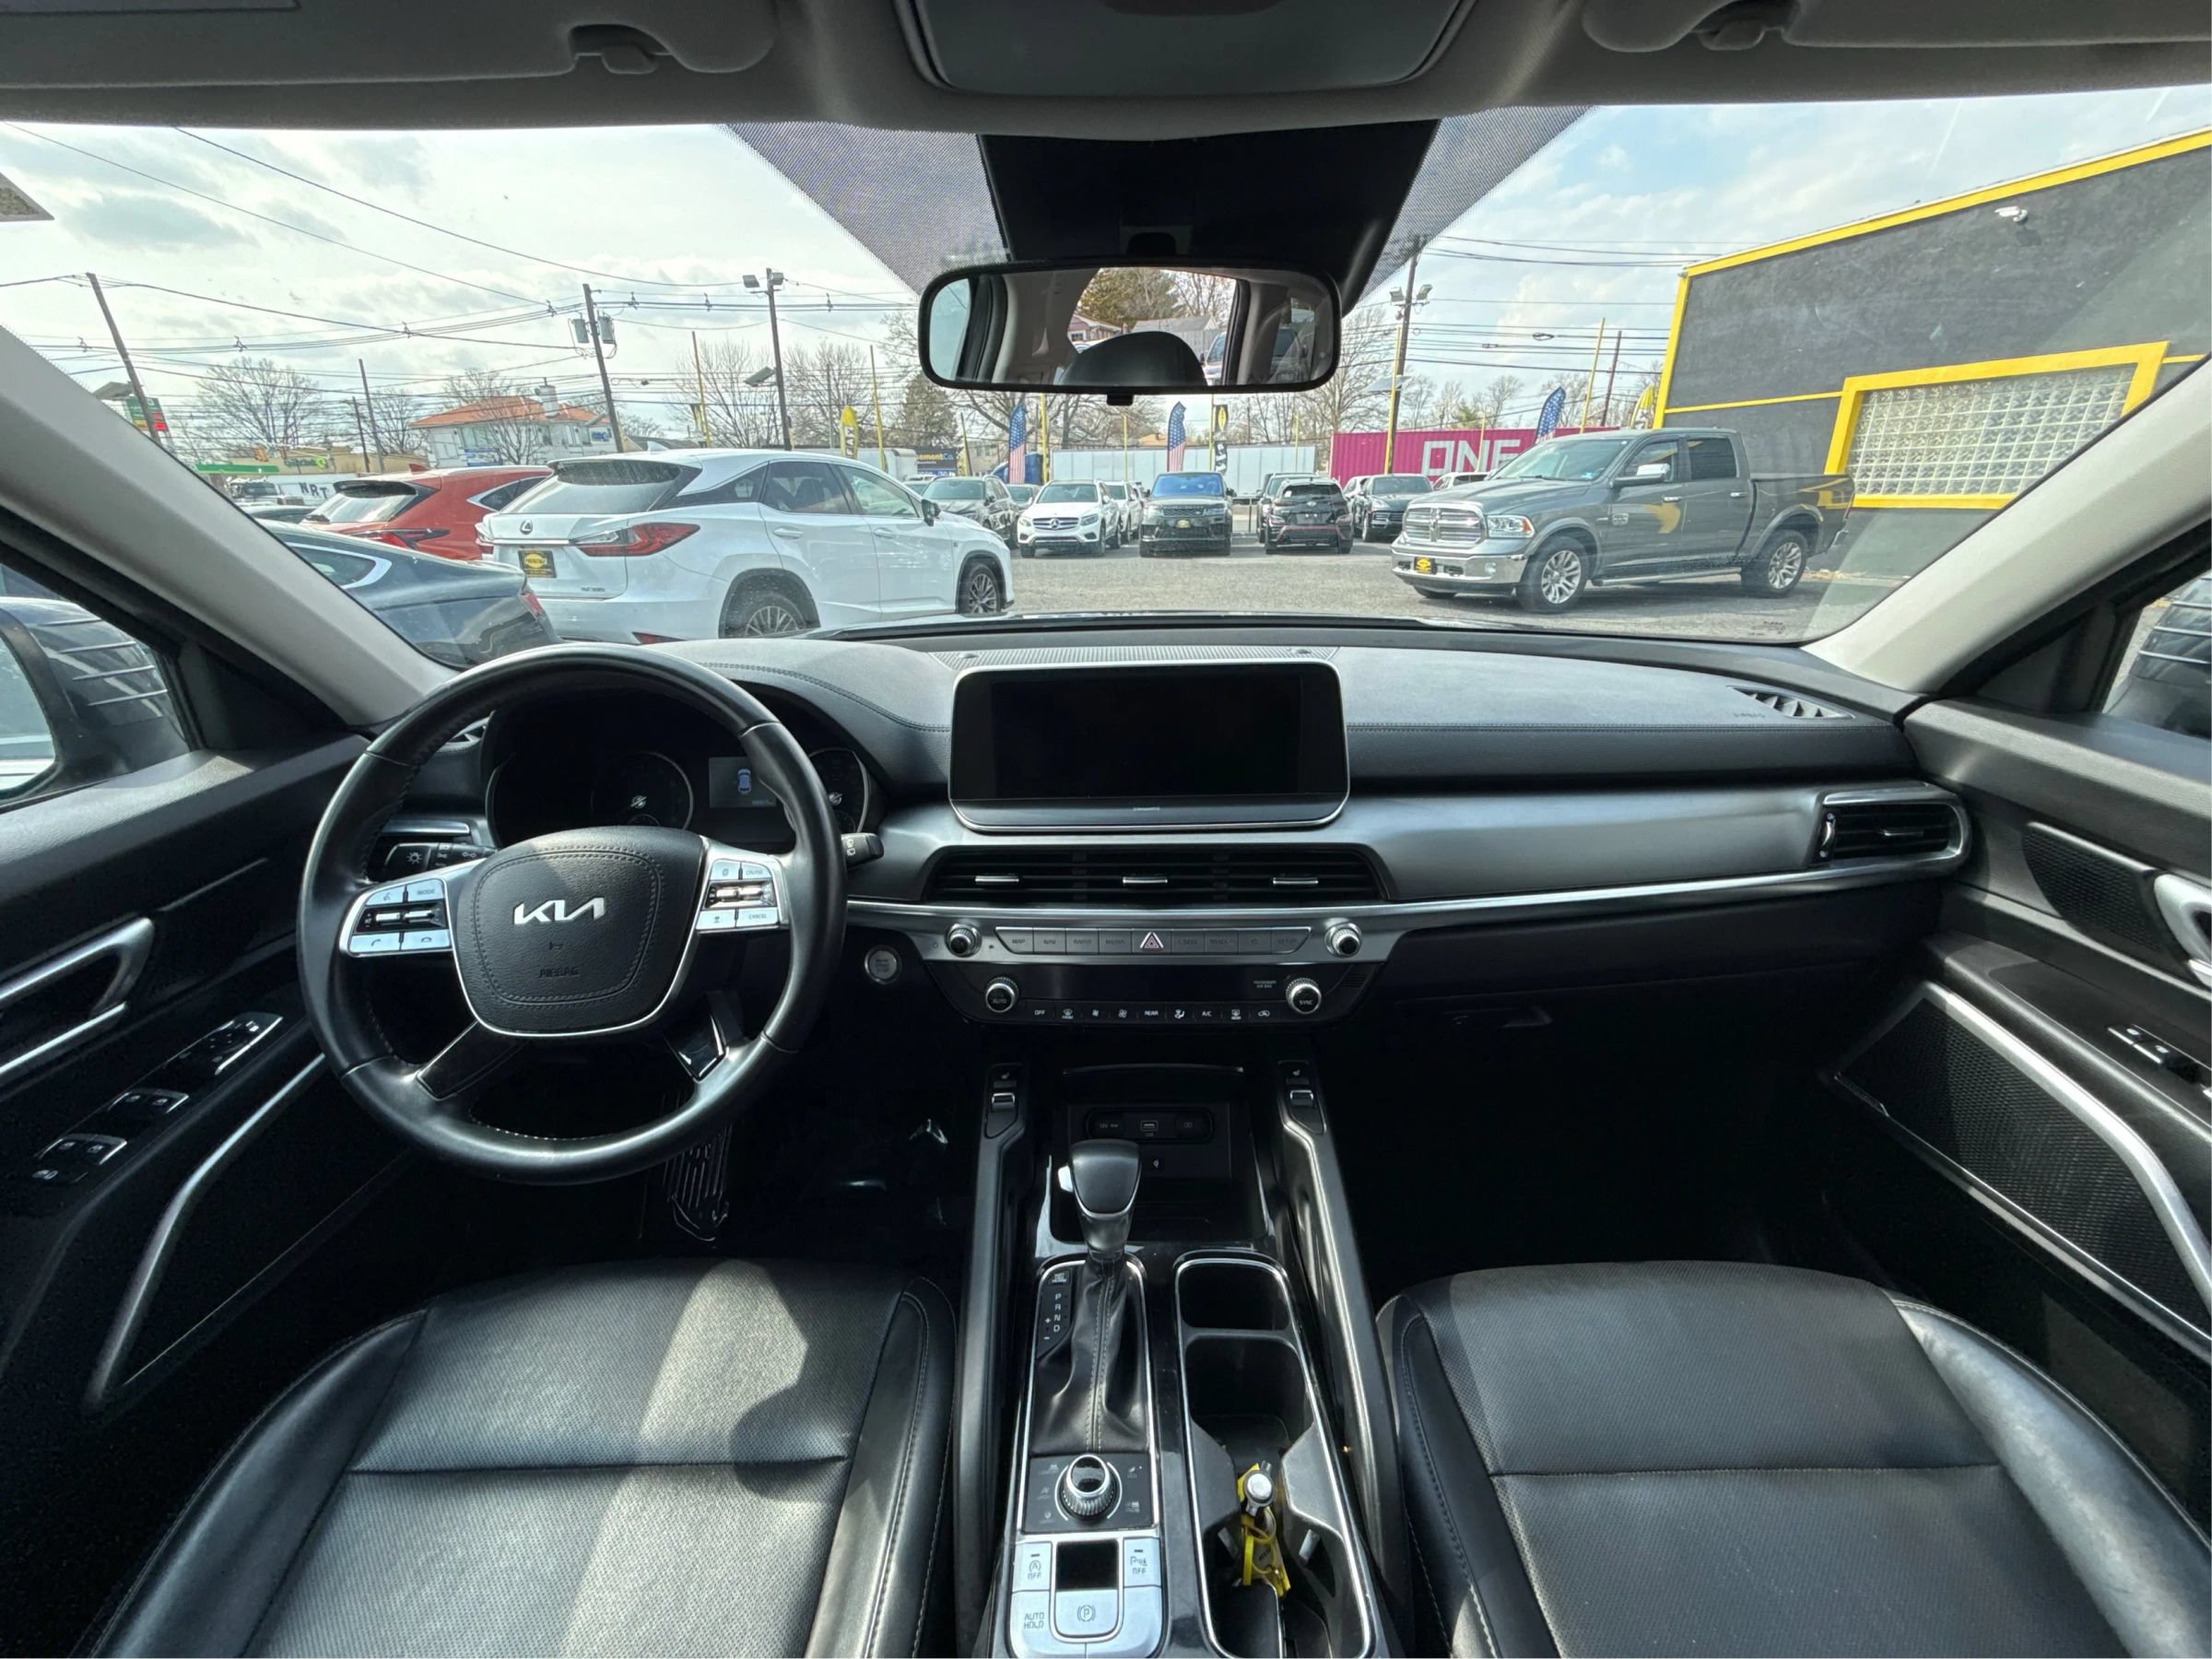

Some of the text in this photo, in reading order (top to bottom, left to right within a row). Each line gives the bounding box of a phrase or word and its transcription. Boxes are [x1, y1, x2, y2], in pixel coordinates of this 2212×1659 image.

[1421, 440, 1521, 476] ONE
[299, 482, 329, 500] NRT
[513, 898, 606, 924] KIA
[1053, 1313, 1061, 1322] N
[1053, 1324, 1061, 1333] D
[1024, 1612, 1044, 1620] AUTO
[1023, 1620, 1044, 1630] HOLD
